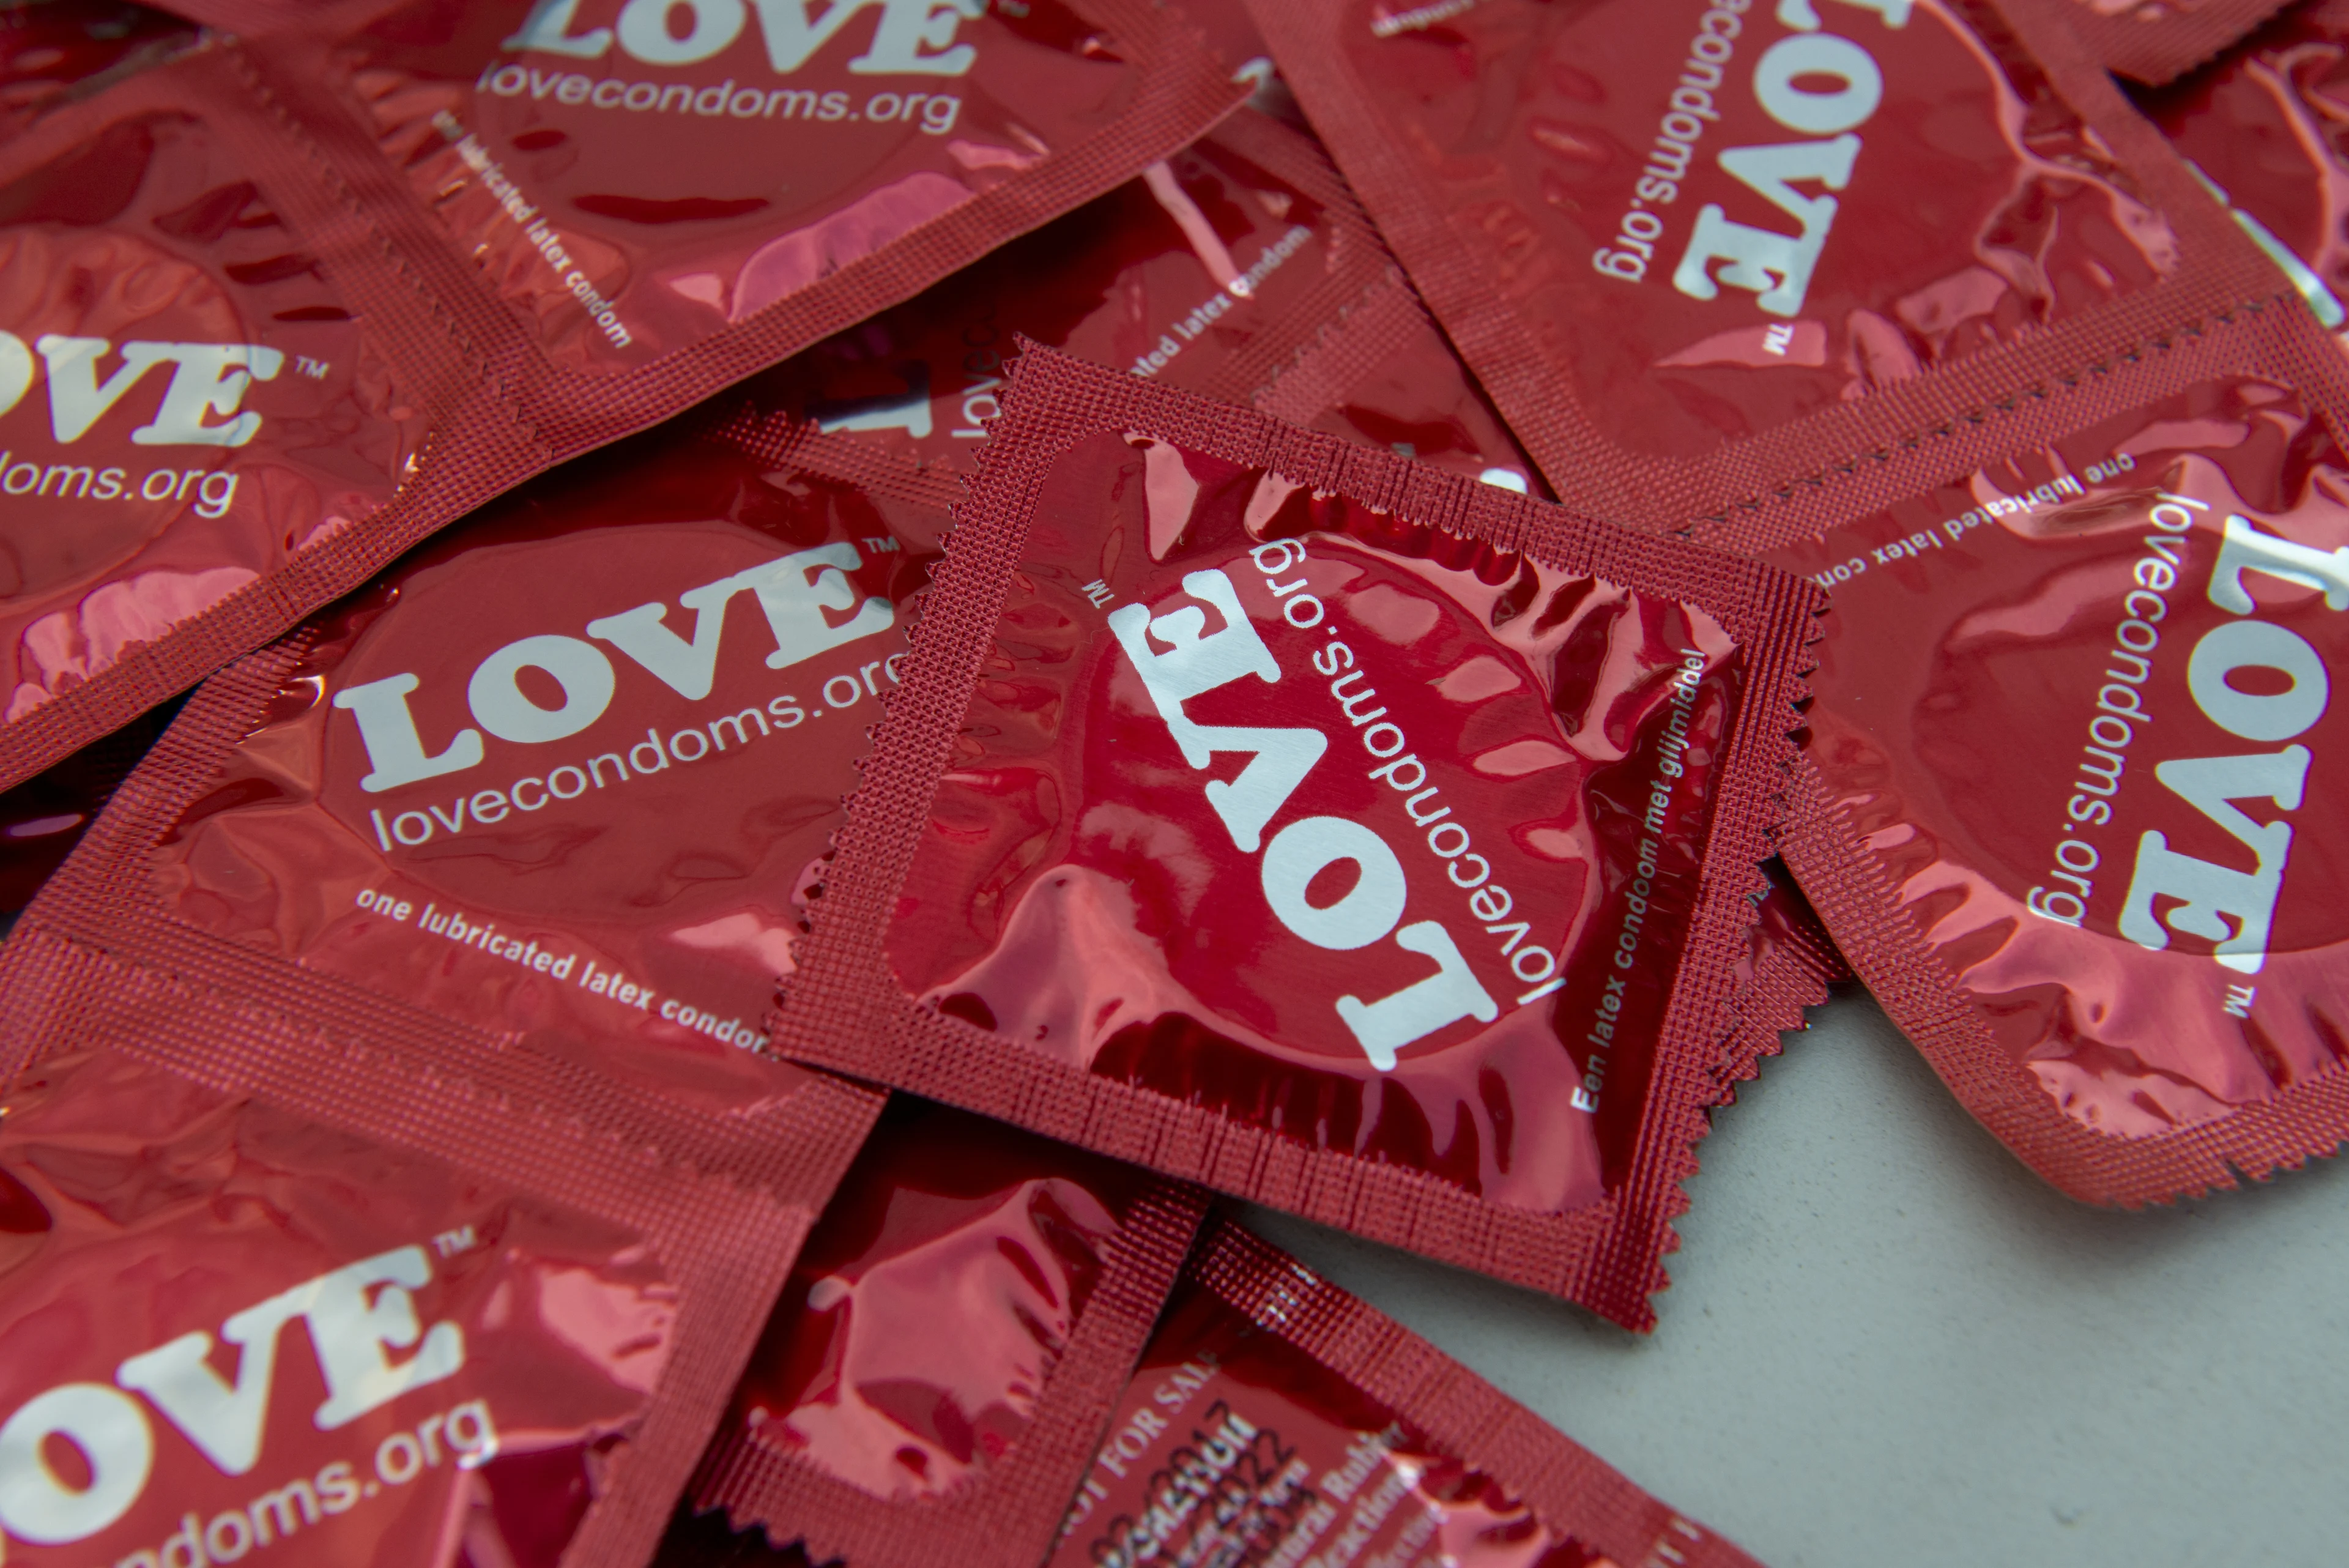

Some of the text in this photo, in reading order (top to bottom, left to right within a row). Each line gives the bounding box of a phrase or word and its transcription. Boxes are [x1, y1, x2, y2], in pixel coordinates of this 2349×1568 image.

[475, 60, 960, 135] lovecondoms.org
[524, 217, 573, 273] latex
[565, 270, 632, 349] condom
[1171, 292, 1233, 340] latex
[1806, 453, 2137, 590] one lubricated latex con
[332, 541, 894, 793] LOVE
[2027, 492, 2210, 927] lovecondoms.org
[2118, 515, 2349, 974] LOVE
[1107, 569, 1499, 1071] LOVE
[1249, 538, 1567, 1005] lovecondoms.org
[356, 887, 412, 922] one
[418, 903, 574, 981] lubricated
[579, 960, 654, 1011] latex
[1570, 648, 1707, 1114] Een latex condoom met glijmiddel
[1097, 1408, 1168, 1479] FOR
[1153, 1348, 1221, 1414] SALE
